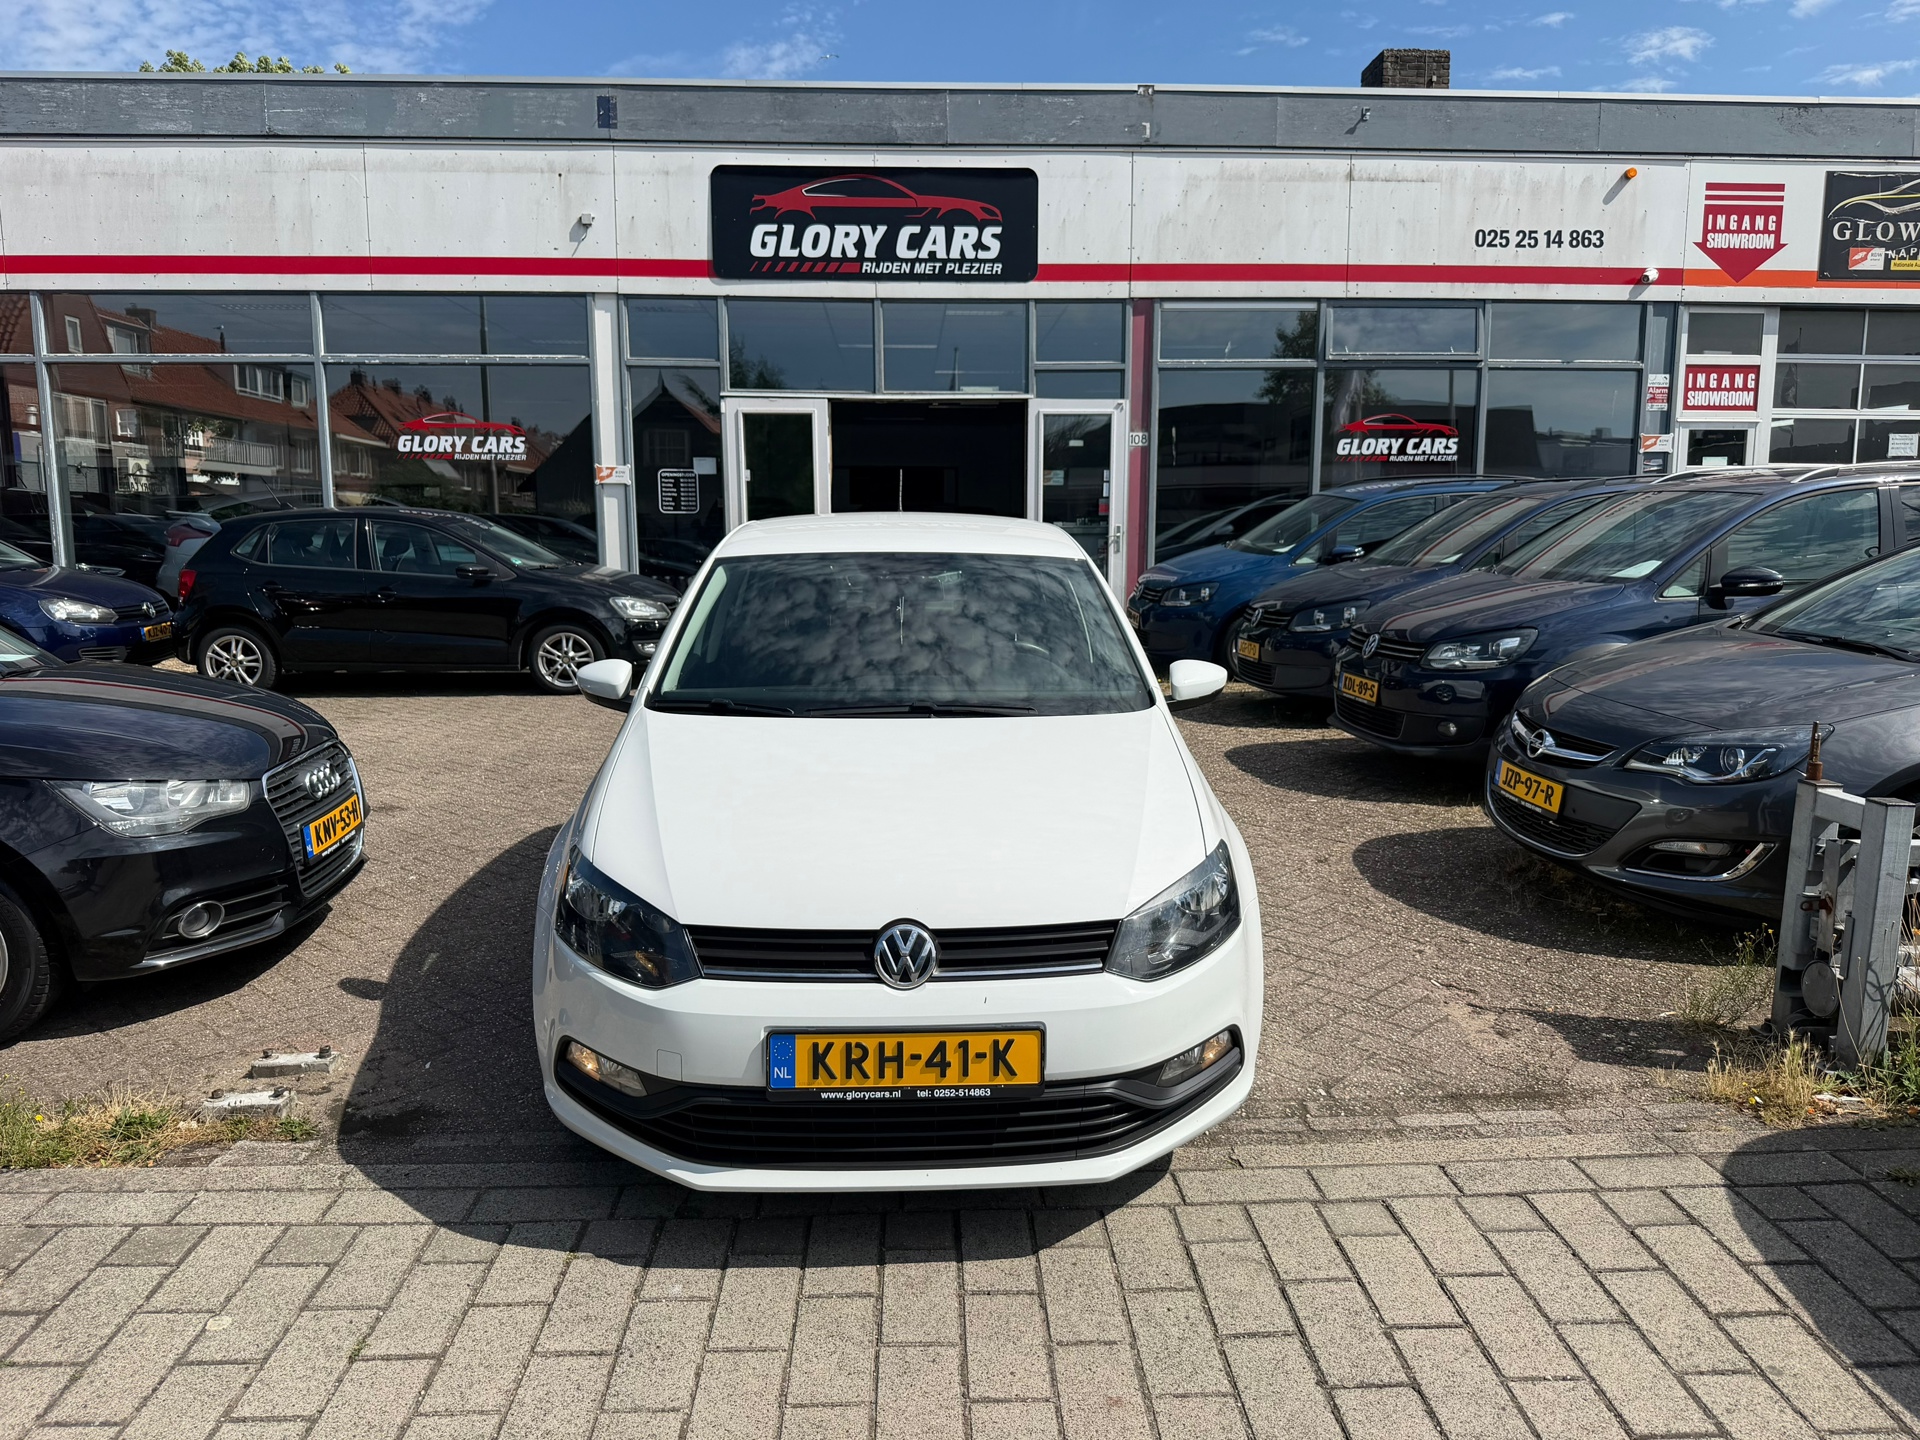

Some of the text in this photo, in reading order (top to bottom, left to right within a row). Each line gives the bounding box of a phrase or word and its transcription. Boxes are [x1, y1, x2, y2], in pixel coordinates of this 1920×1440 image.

[1707, 214, 1776, 231] INGANG
[750, 224, 1002, 259] GLORY CARS
[1474, 229, 1604, 249] 025 25 14 863
[1706, 233, 1775, 249] SHOWROOM
[862, 262, 1002, 275] RIJDEN MET PLEZIER
[1687, 373, 1755, 389] INGANG
[1686, 390, 1754, 407] SHOWROOM
[397, 435, 526, 453] GLORY CARS
[1130, 433, 1148, 445] 108
[1336, 437, 1459, 455] GLORY CARS
[1343, 675, 1376, 698] KDL-89-S
[1502, 767, 1554, 807] JZP-97-R
[314, 799, 359, 848] KNV-53-H
[812, 1038, 1018, 1080] KRH-41-K
[773, 1066, 792, 1079] NL
[820, 1088, 991, 1100] www.glorycars.nl tel: 0252-514863
